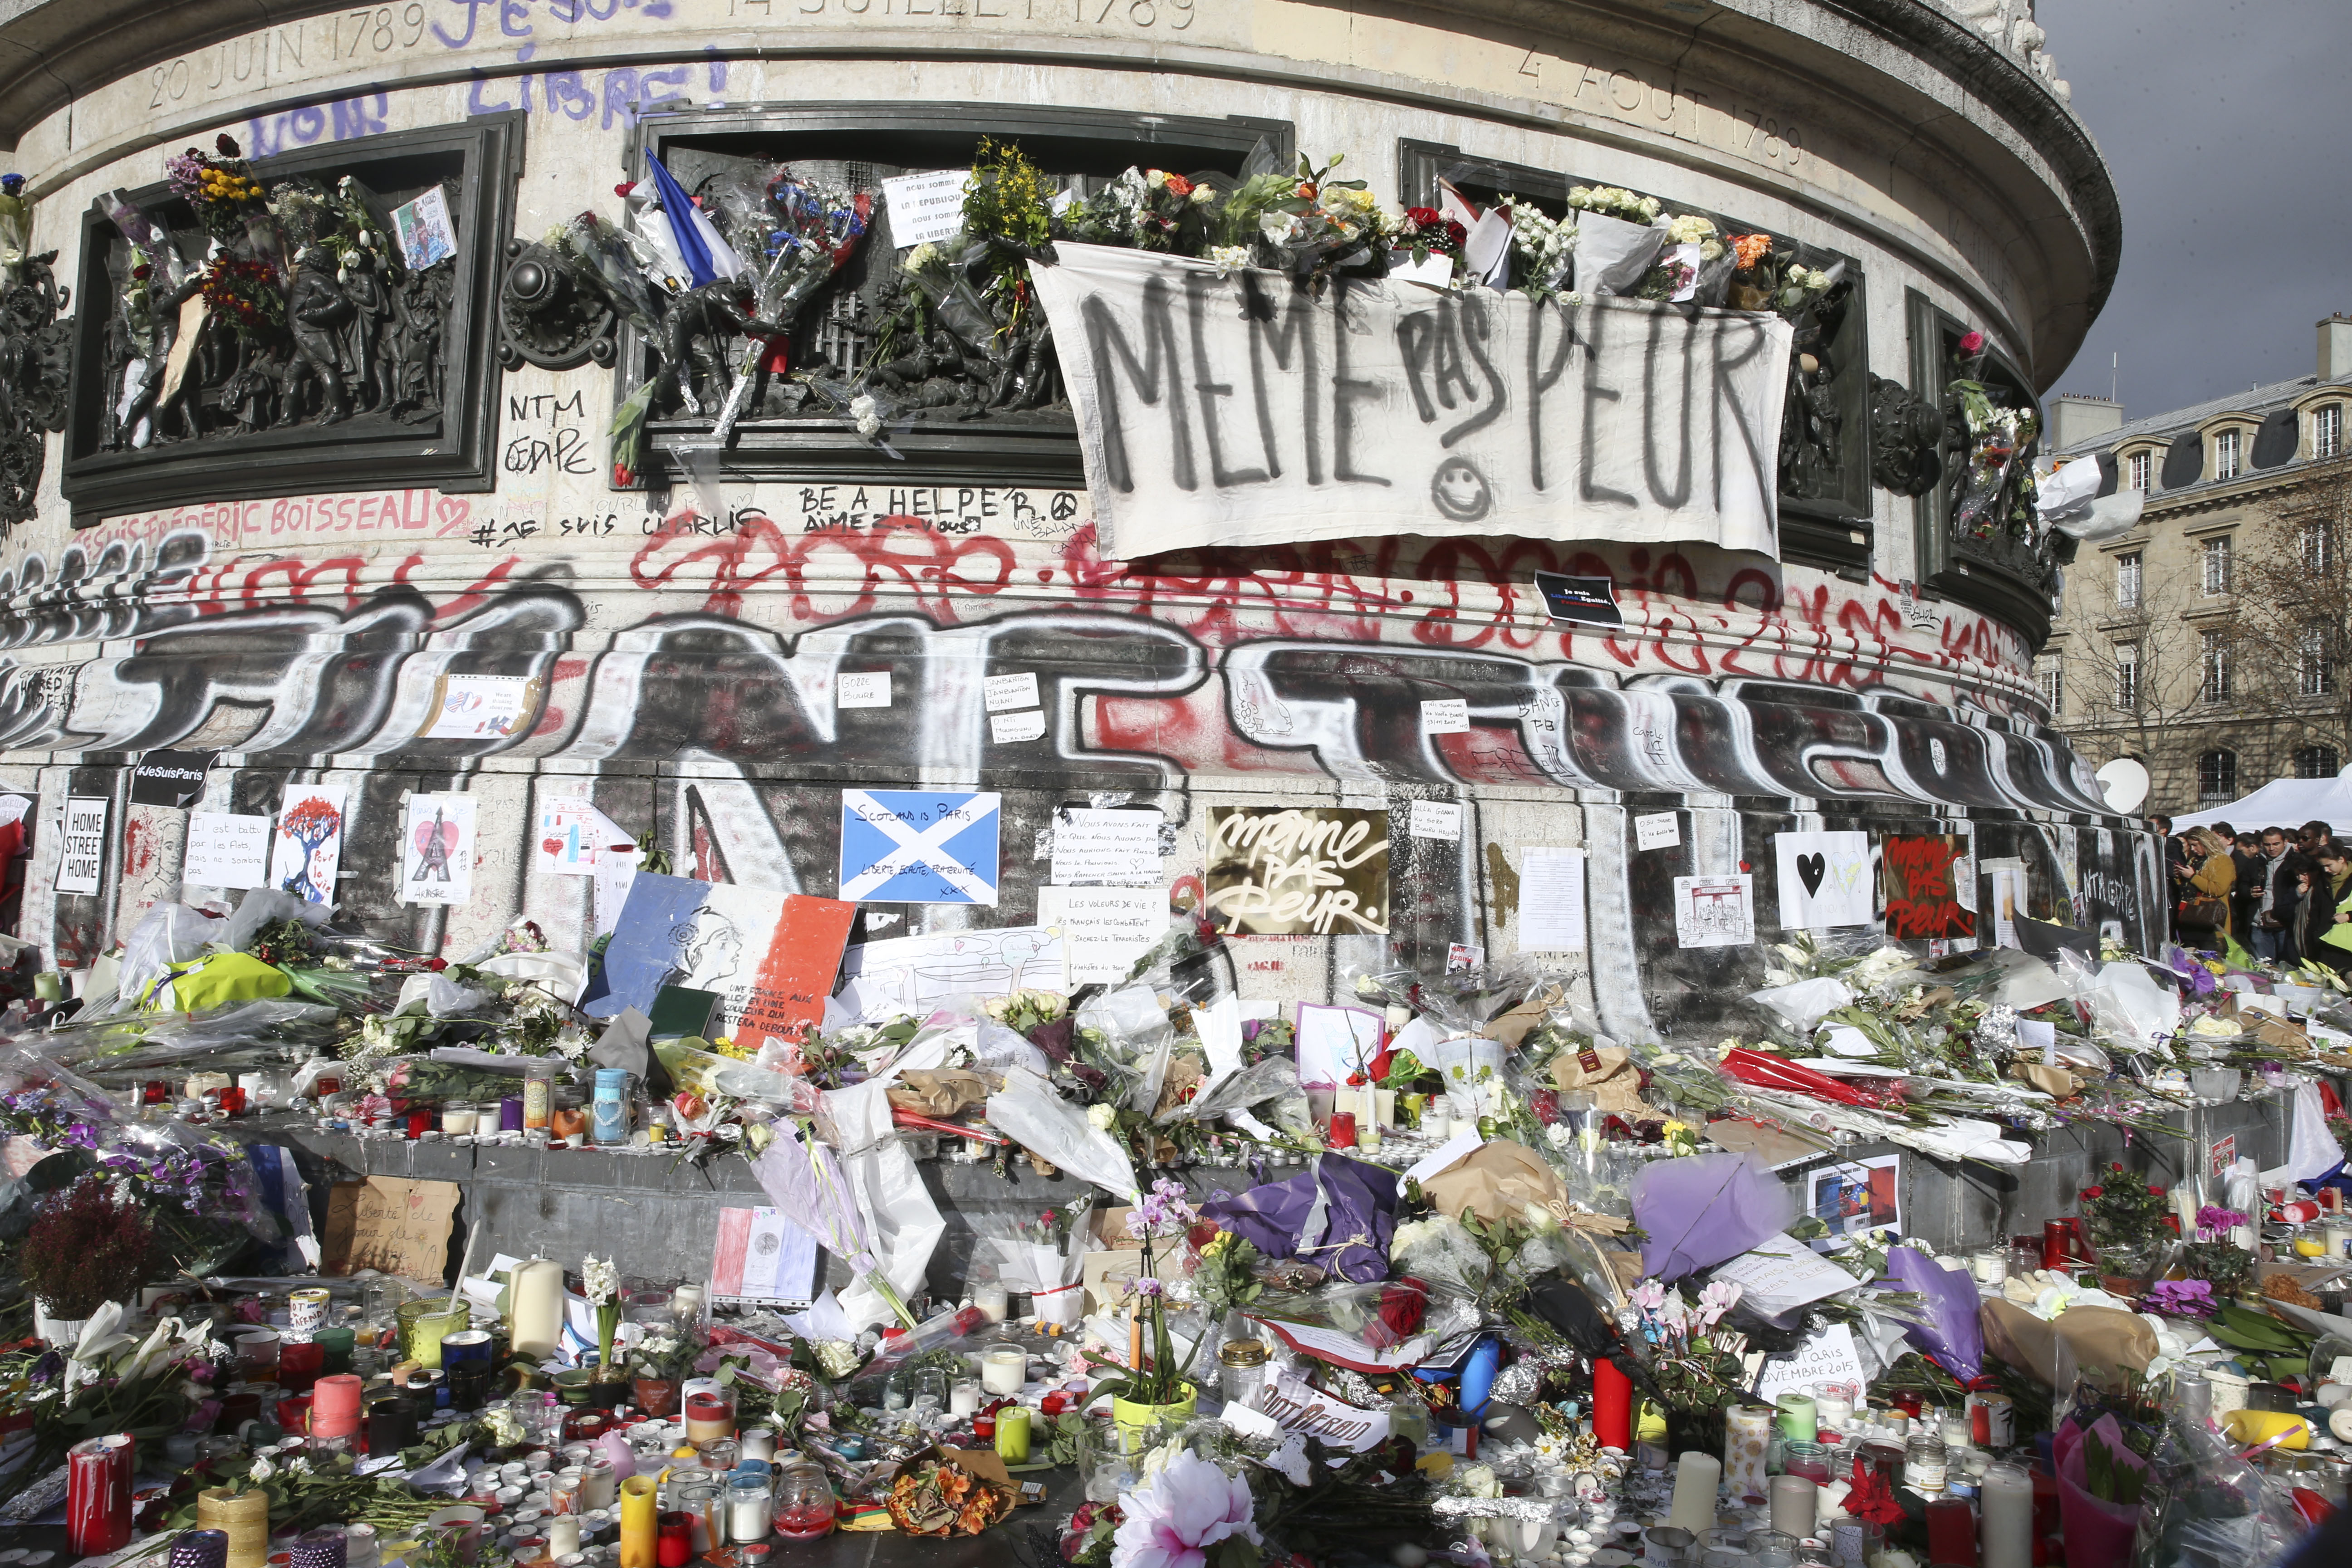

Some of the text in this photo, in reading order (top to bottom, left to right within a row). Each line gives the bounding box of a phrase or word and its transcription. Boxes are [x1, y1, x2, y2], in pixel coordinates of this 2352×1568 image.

[150, 2, 426, 110] 20 JUIN 1789
[1518, 44, 1803, 165] 4 AOUT 1789
[929, 178, 958, 189] SOMME
[913, 193, 961, 208] EPUBLIQU
[927, 227, 960, 239] LIBERT
[510, 390, 584, 428] NTM
[1081, 271, 1778, 533] MEME PAS PEUR
[799, 486, 838, 514] BE
[852, 486, 868, 510] A
[137, 765, 203, 782] #JeSuisParis
[855, 804, 915, 822] SCOTLAND
[937, 803, 971, 822] PARIS
[72, 813, 102, 832] HOME
[213, 824, 229, 833] est
[65, 836, 103, 856] STREET
[190, 840, 205, 849] par
[231, 855, 262, 864] sombre
[67, 859, 98, 879] HOME
[1069, 898, 1084, 909] LES
[749, 986, 785, 1000] FRANCE
[724, 1004, 764, 1016] COULEUR
[714, 1013, 755, 1028] RESTERA
[331, 1192, 436, 1221] Liberté de
[1747, 1268, 1784, 1288] AMAIS
[1756, 1278, 1789, 1296] AMAIS
[1826, 1361, 1854, 1374] 2015
